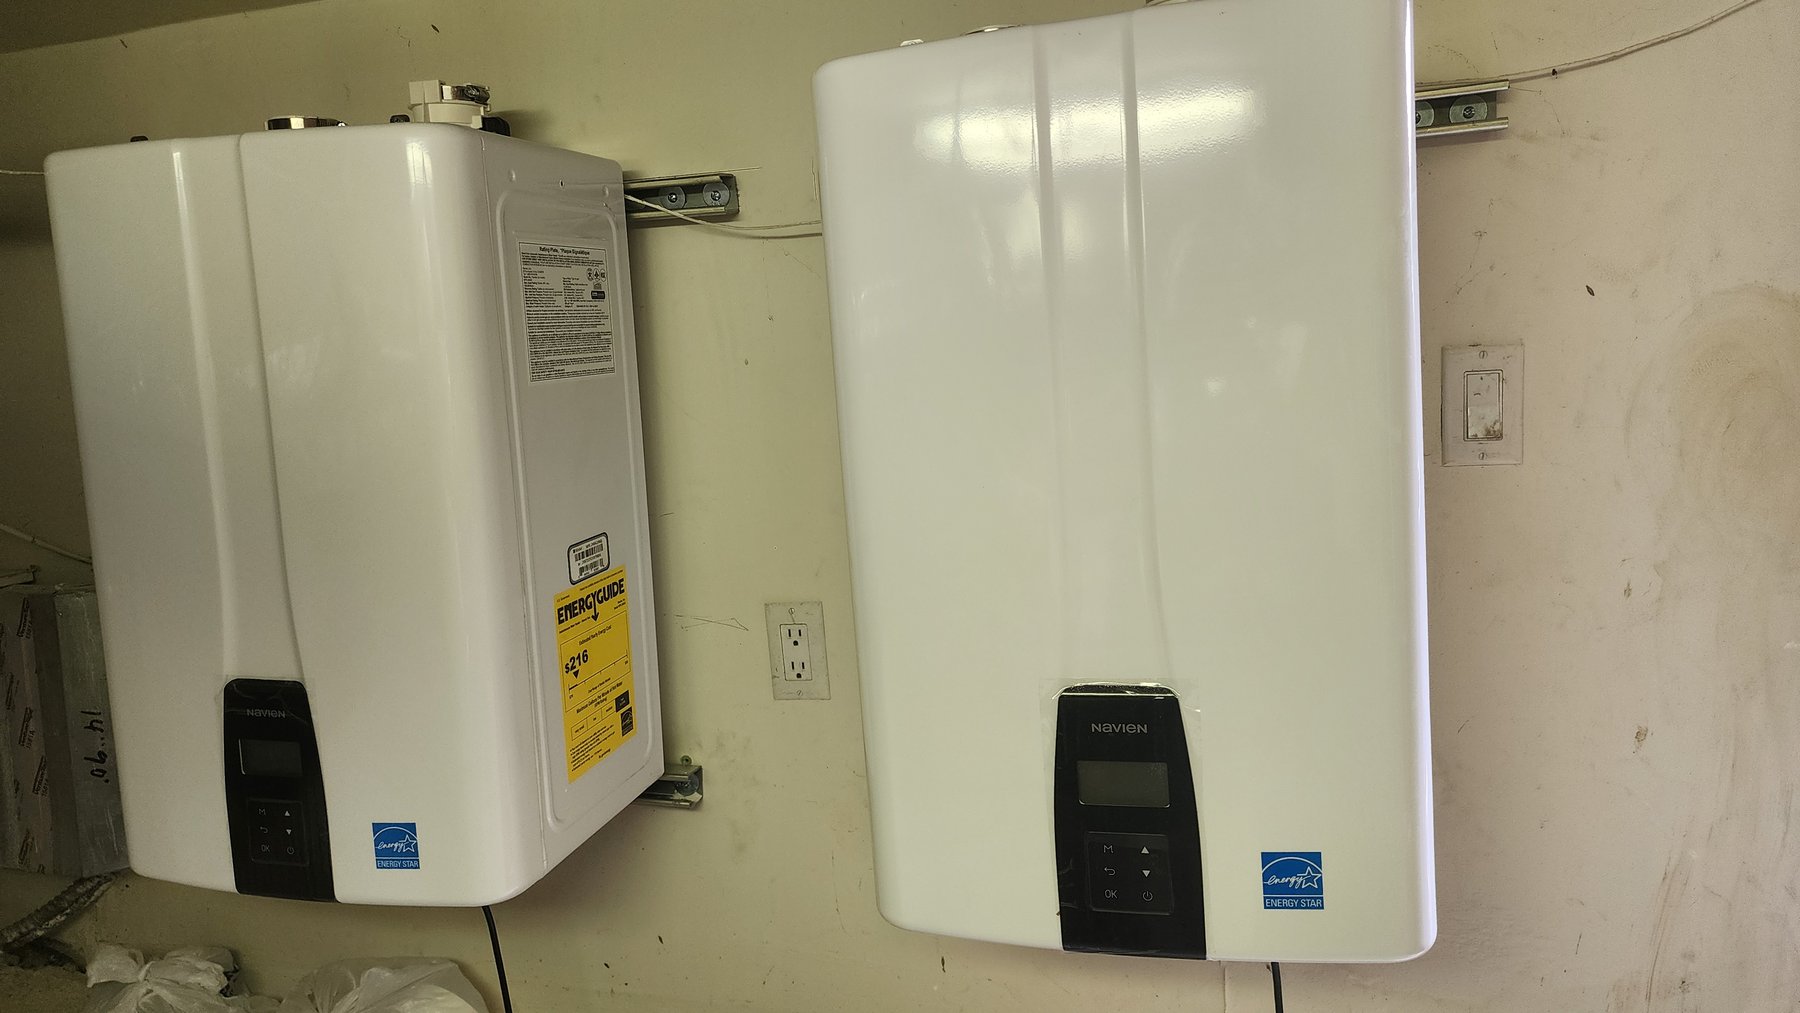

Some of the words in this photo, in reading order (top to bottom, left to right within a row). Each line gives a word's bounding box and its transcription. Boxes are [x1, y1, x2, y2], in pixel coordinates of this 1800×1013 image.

[556, 577, 625, 625] ENERGYGUIDE
[564, 649, 588, 674] $216
[258, 808, 266, 816] M
[260, 844, 271, 853] OK
[1103, 844, 1114, 854] M
[377, 860, 402, 868] ENERGY
[402, 860, 419, 868] STAR
[1264, 874, 1307, 889] energy
[1104, 889, 1118, 899] OK
[1265, 898, 1299, 907] ENERGY
[1300, 898, 1322, 907] STAR
